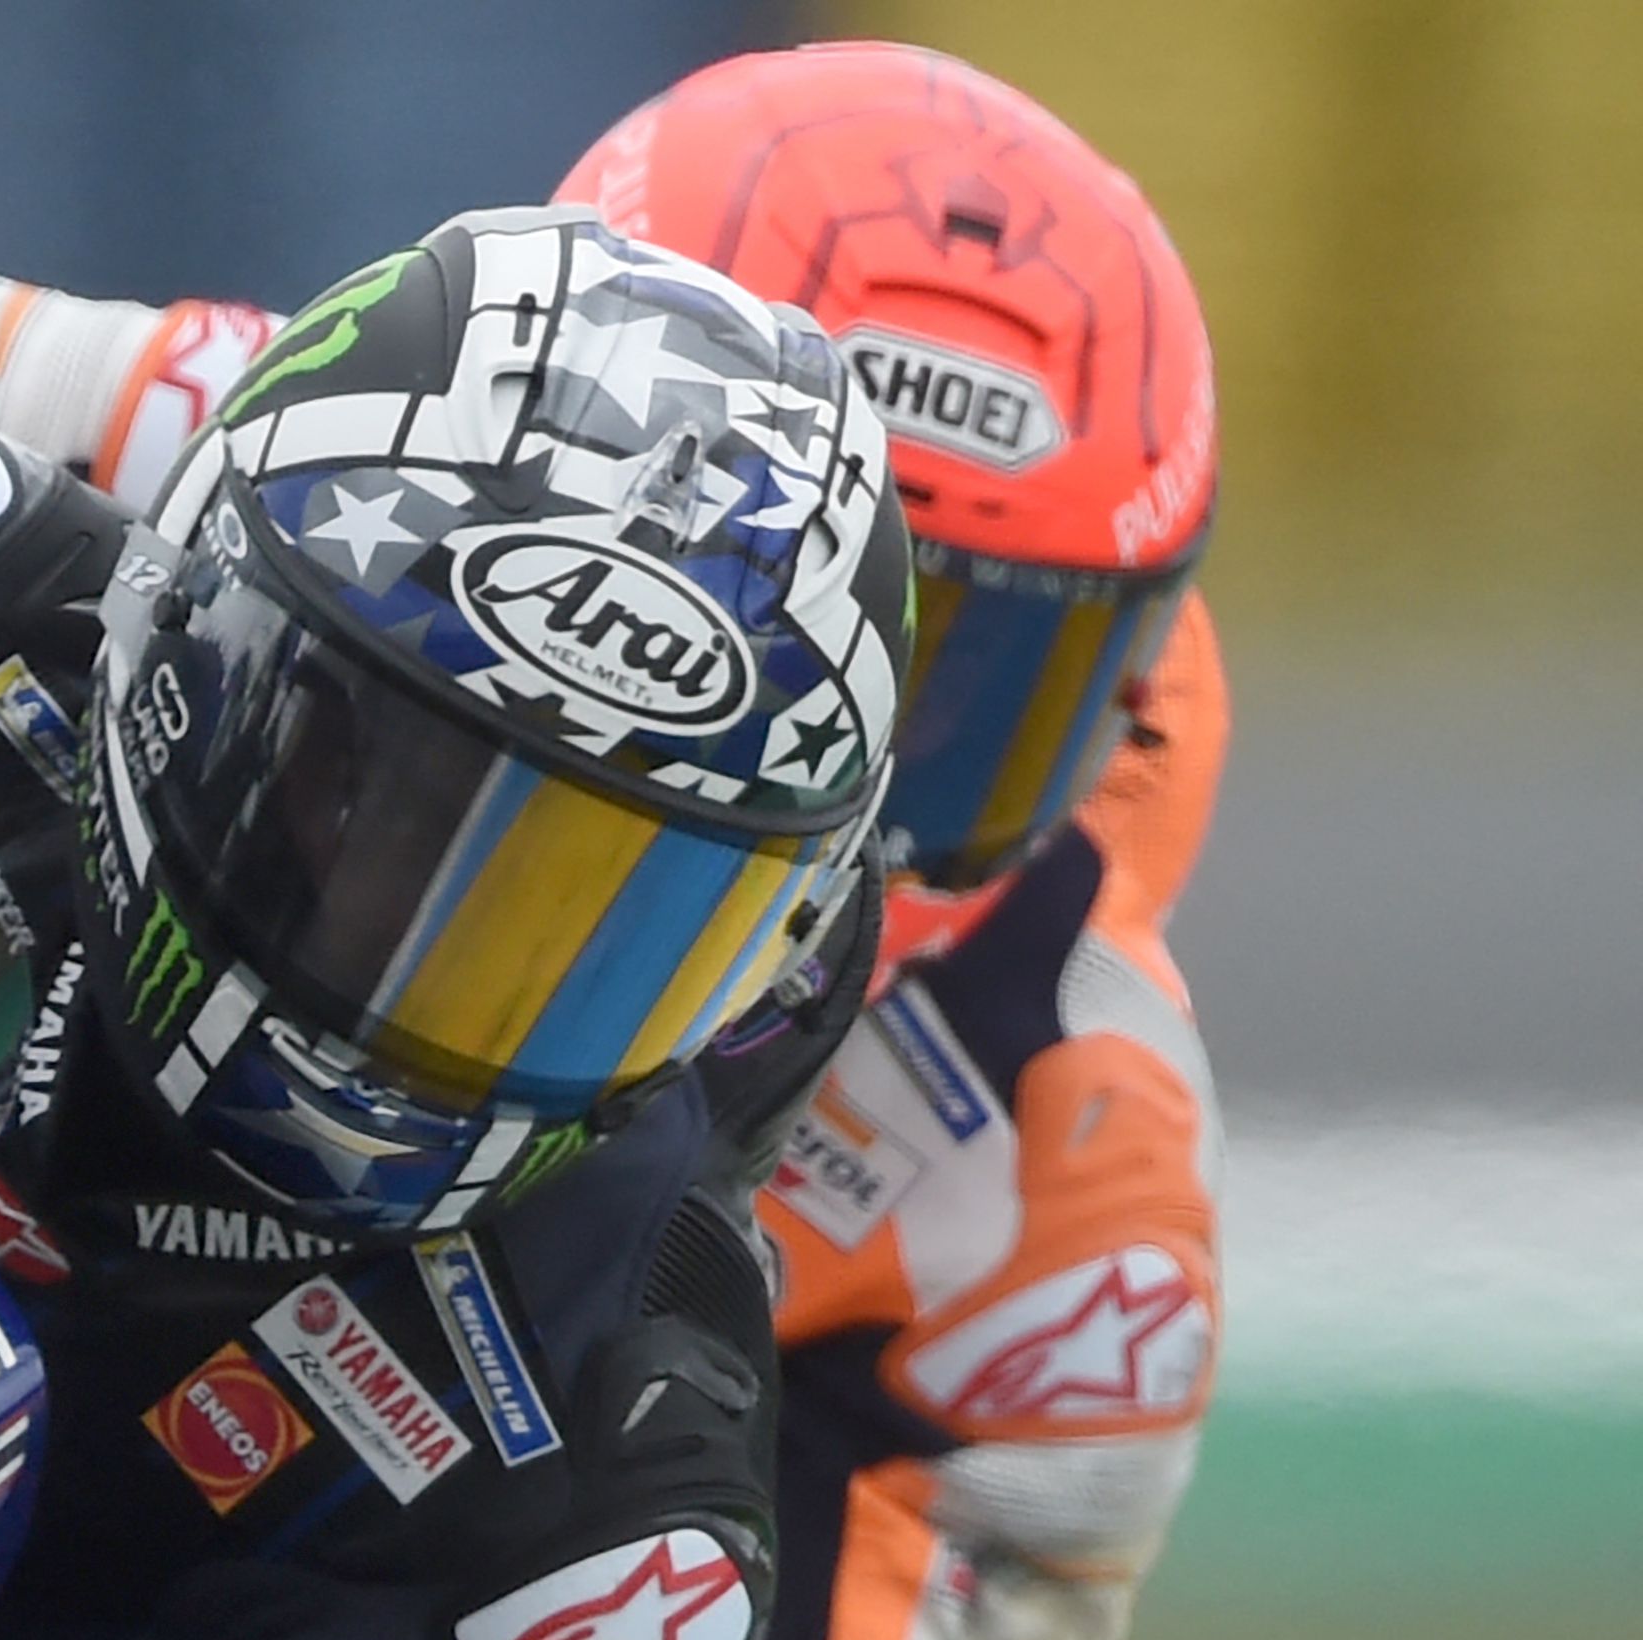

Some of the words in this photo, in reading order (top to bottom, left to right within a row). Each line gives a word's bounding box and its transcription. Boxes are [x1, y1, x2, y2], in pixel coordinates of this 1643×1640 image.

[852, 347, 1029, 449] SHOEI
[473, 558, 729, 699] Arai
[539, 639, 651, 702] HELMET
[324, 1320, 457, 1472] YAMAHA
[453, 1295, 531, 1435] MICHELIN
[186, 1379, 269, 1474] ENEOS
